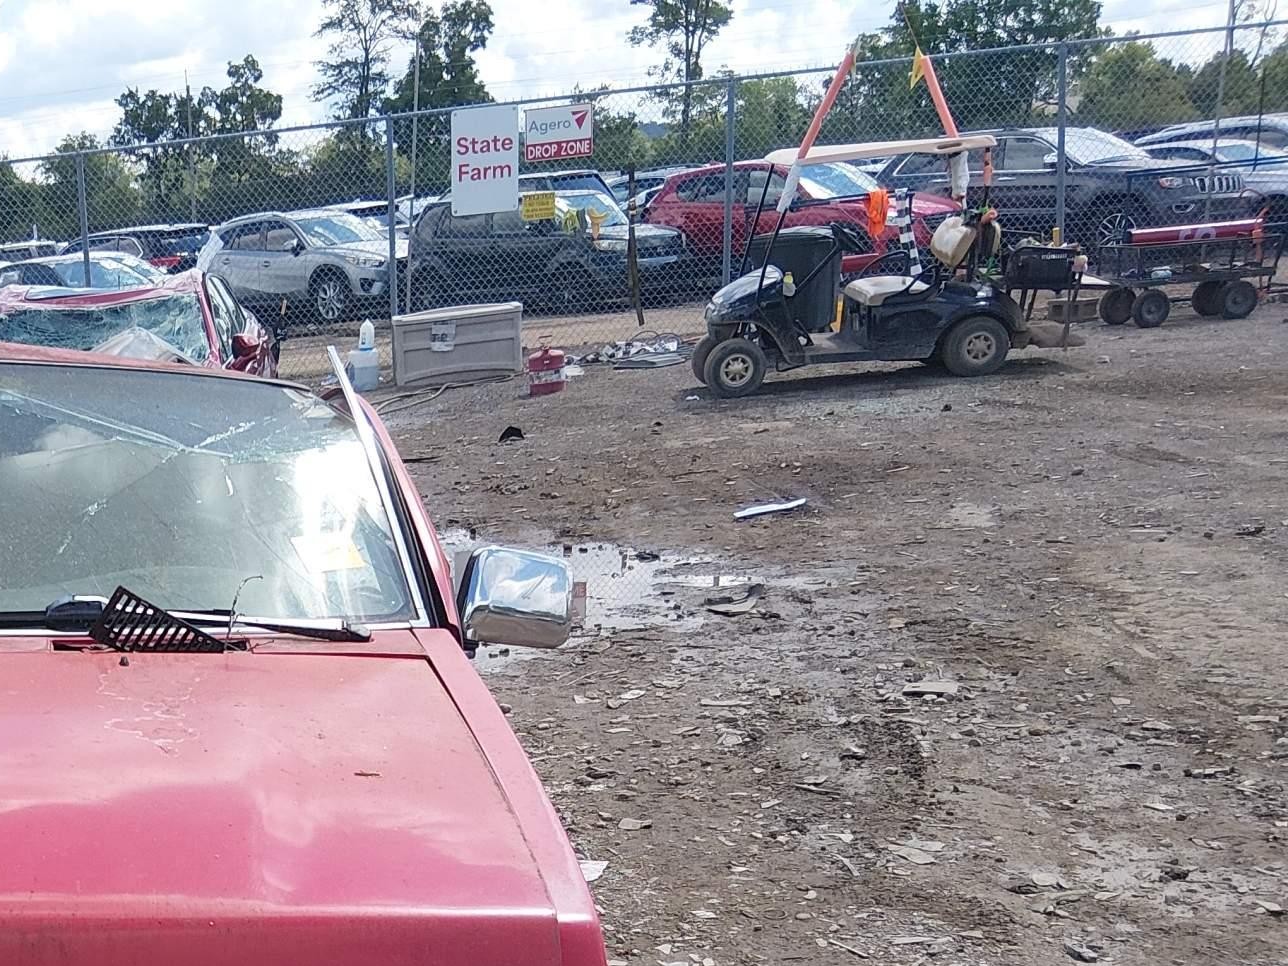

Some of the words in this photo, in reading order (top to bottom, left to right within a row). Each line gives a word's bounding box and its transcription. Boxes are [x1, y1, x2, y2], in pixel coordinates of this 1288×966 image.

[529, 120, 571, 135] Agero
[456, 135, 514, 156] State
[527, 144, 559, 160] DROP
[560, 140, 590, 156] ZONE
[457, 163, 512, 183] Farm
